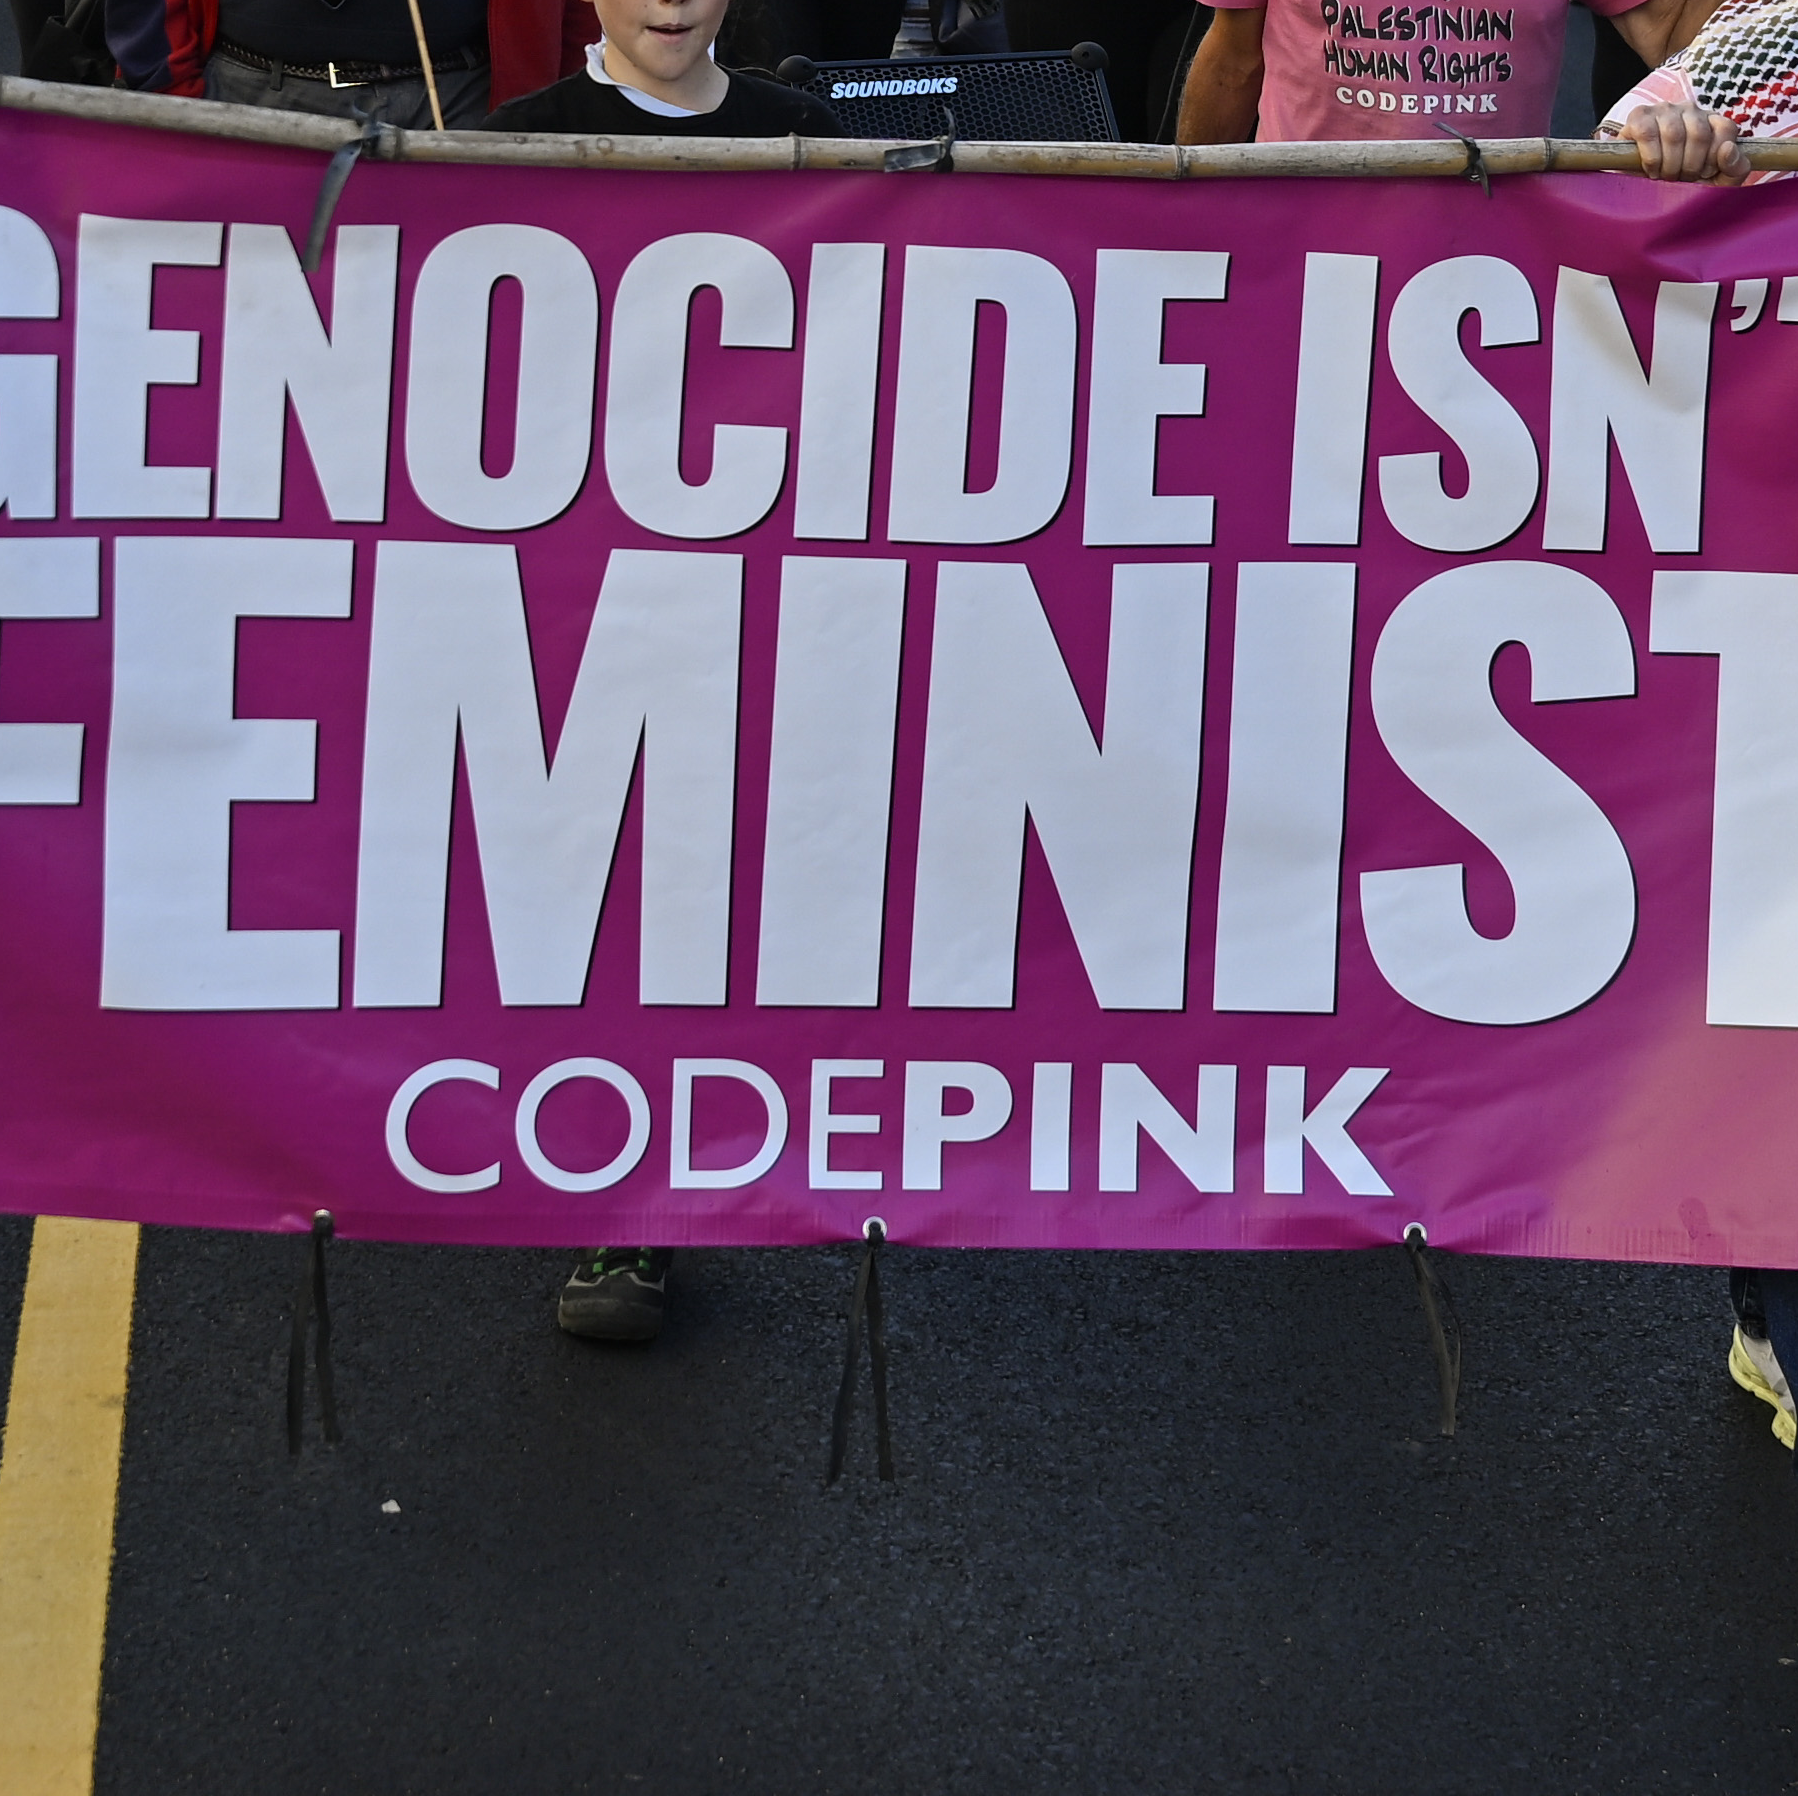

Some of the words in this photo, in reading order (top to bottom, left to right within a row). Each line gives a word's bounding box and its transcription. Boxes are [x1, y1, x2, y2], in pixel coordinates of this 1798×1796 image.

[1323, 39, 1409, 84] HUMAN
[1418, 44, 1514, 90] RIGHTS
[830, 77, 958, 99] SOUNDBOKS
[1335, 85, 1498, 115] CODEPINK
[385, 1056, 1394, 1198] CODEPINK
